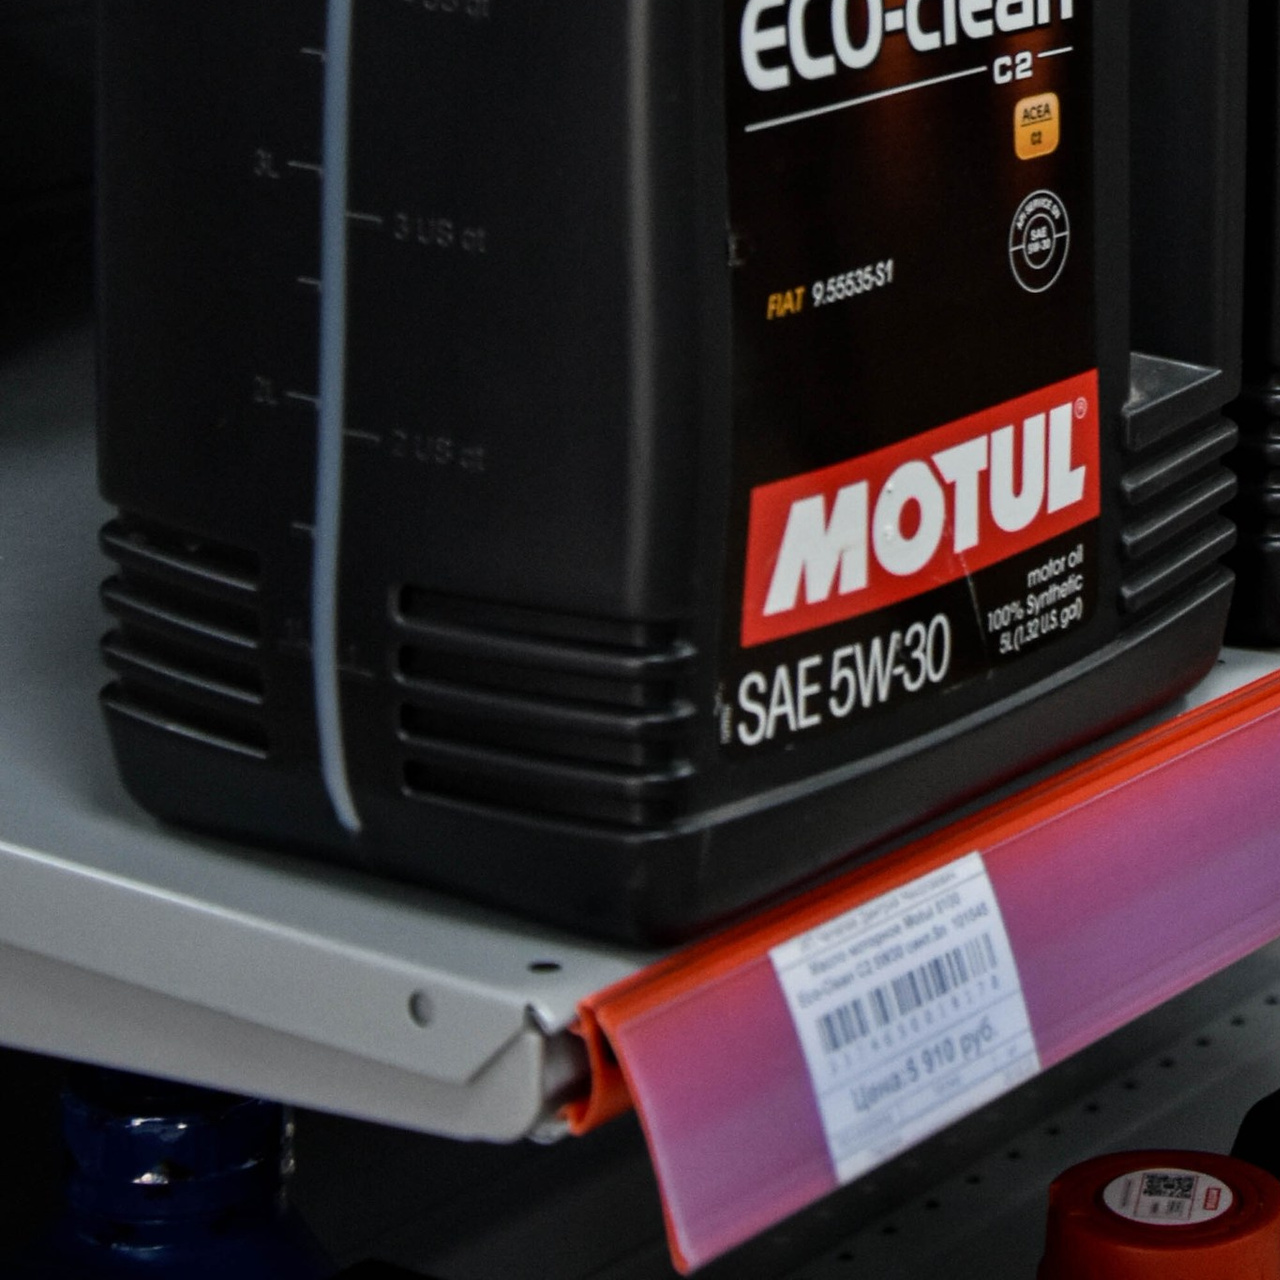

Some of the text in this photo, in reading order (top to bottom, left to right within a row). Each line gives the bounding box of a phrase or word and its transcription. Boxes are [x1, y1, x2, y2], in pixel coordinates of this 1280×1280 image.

[993, 51, 1033, 85] C2
[1022, 103, 1051, 121] ACEA
[766, 259, 894, 320] FIAT 9.55535-S1
[763, 401, 1086, 617] MOTUL
[1027, 543, 1084, 588] motor oil
[987, 574, 1084, 633] 100% Synthetic
[737, 655, 822, 746] SAE
[829, 614, 950, 718] 5W-30
[960, 1016, 996, 1060] руб.
